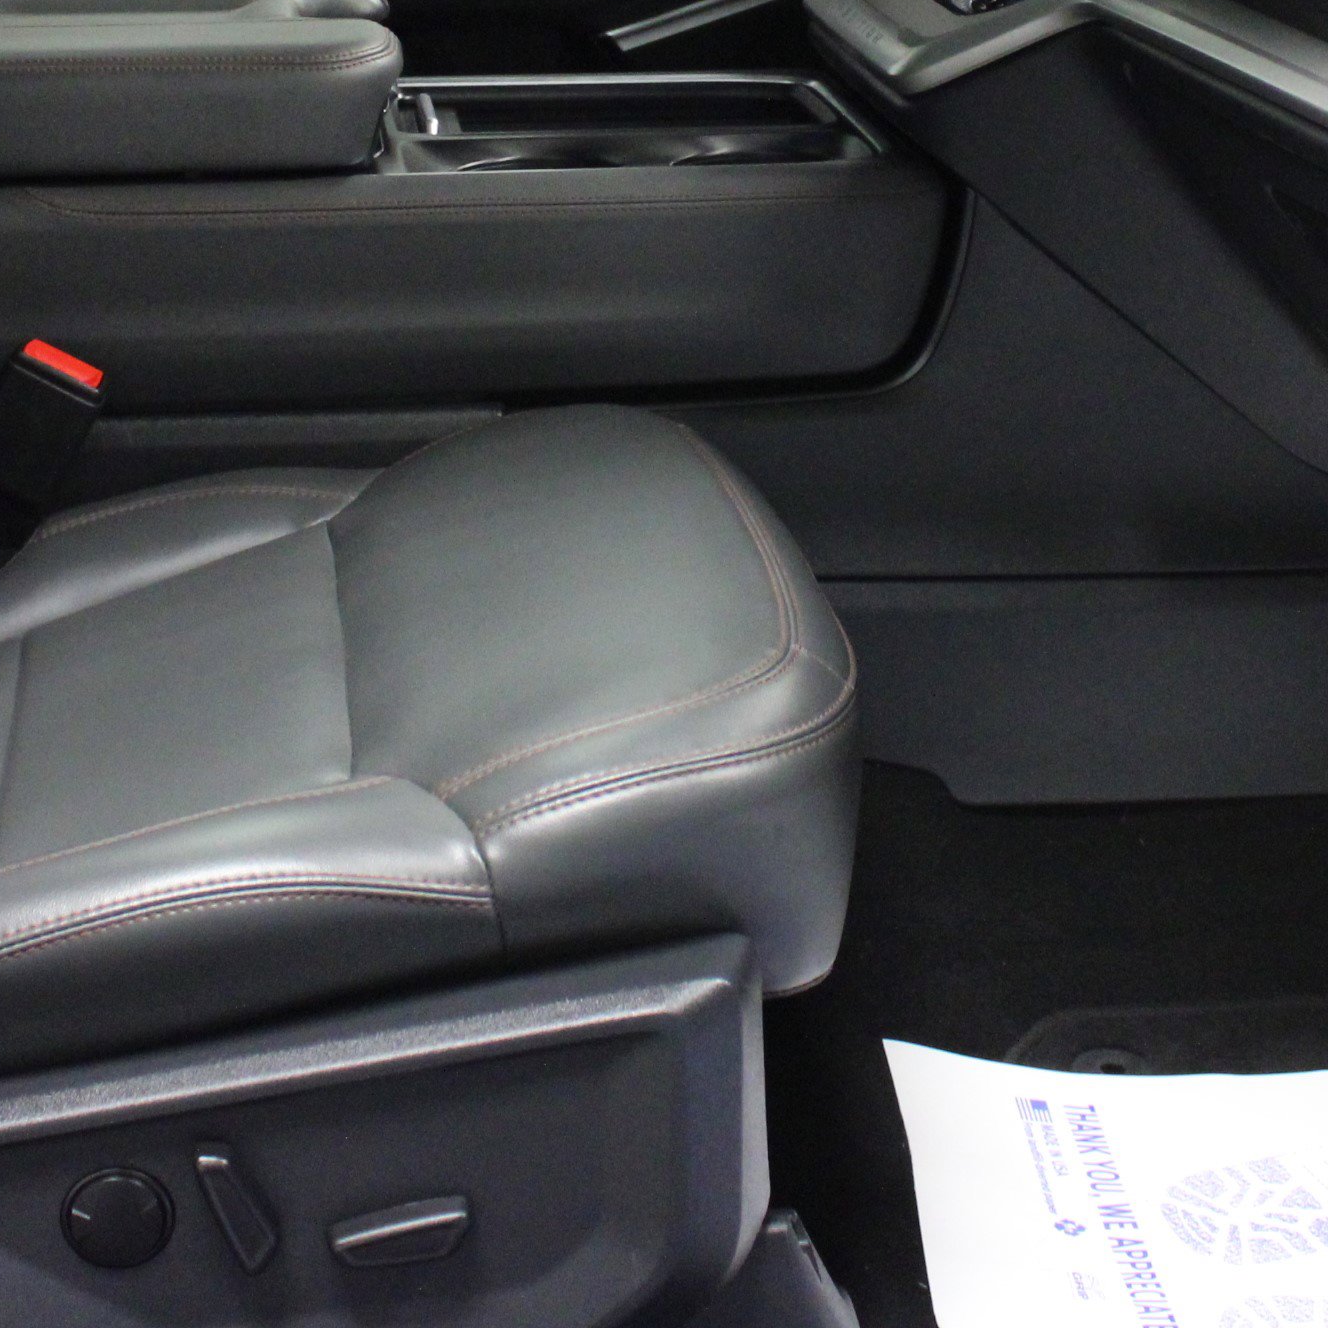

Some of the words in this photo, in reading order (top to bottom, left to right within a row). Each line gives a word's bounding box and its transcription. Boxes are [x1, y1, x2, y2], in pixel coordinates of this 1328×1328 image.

[1063, 1104, 1112, 1156] THANK
[1083, 1160, 1126, 1198] YOU,
[1097, 1202, 1140, 1230] WE
